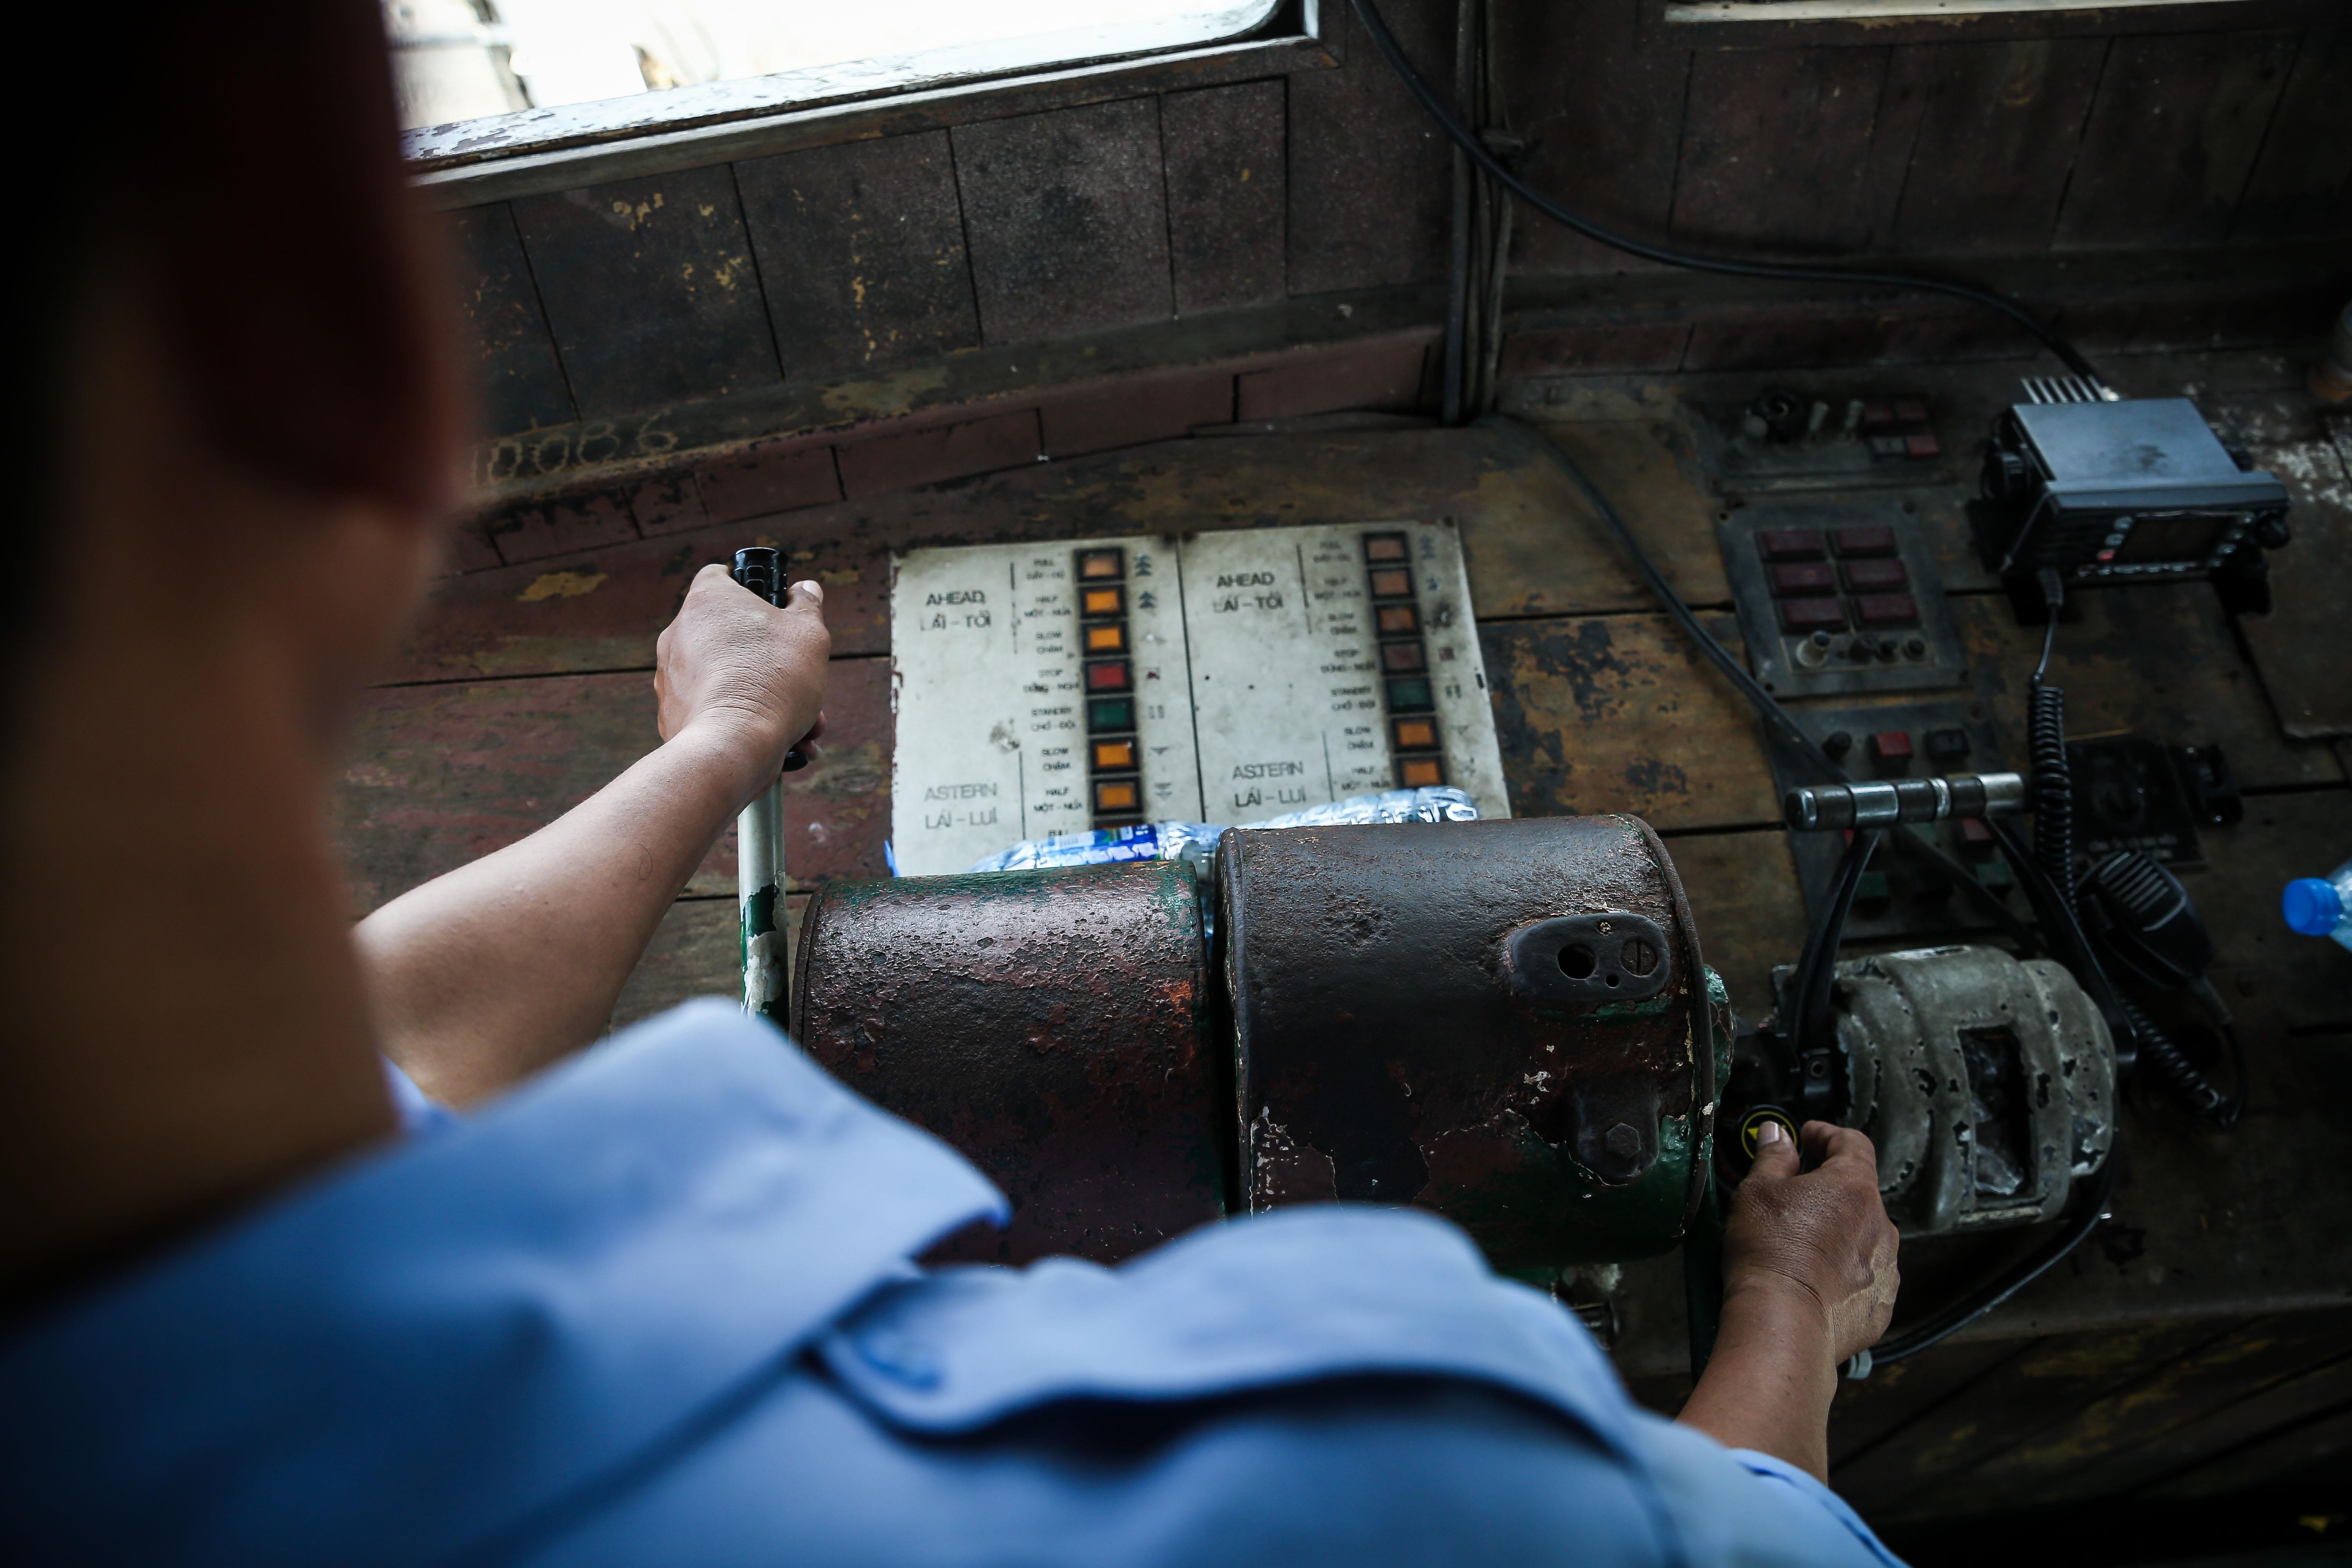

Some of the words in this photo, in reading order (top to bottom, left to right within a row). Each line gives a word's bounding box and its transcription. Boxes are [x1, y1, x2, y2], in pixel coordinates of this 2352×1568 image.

[1216, 572, 1275, 588] AHEAD
[926, 589, 986, 606] AHEAD
[1232, 761, 1304, 780] ASTERN
[924, 782, 997, 802] ASTERN
